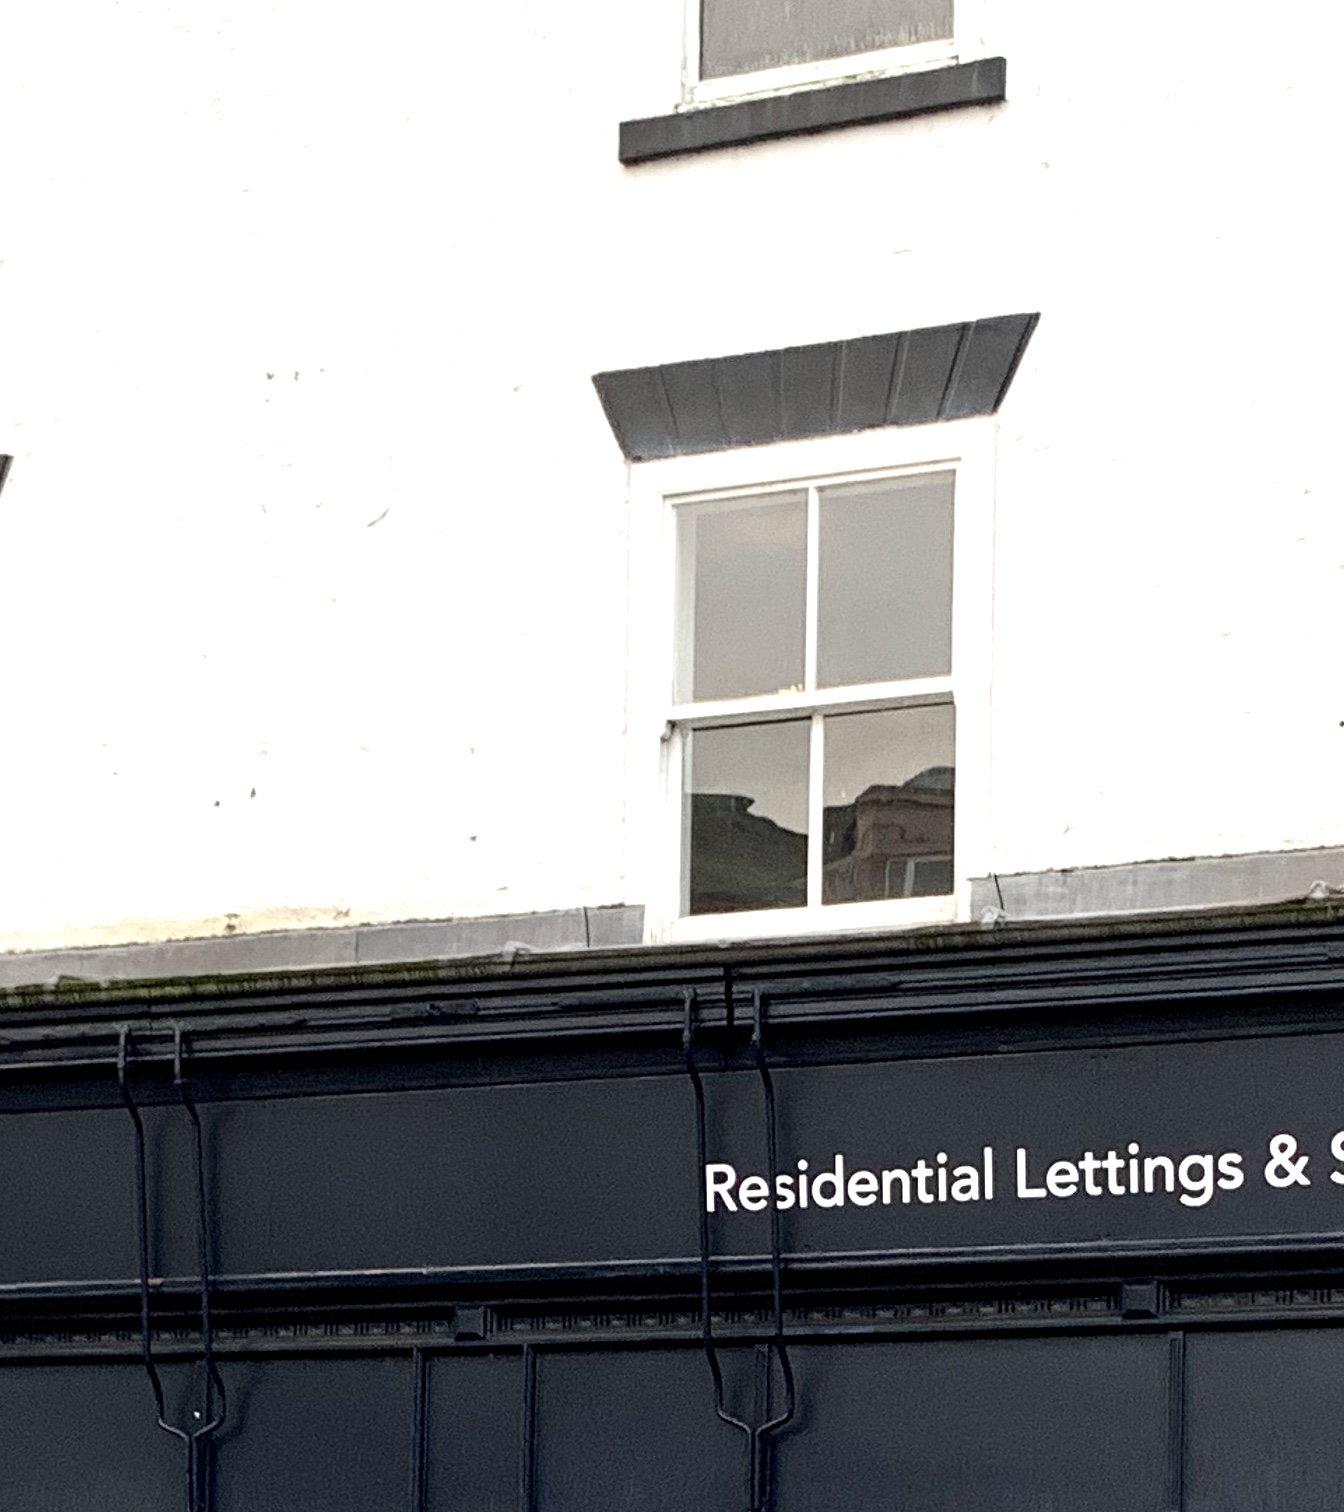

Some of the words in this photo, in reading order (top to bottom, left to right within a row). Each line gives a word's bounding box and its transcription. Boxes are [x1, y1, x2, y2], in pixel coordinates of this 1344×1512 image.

[705, 1147, 995, 1213] Residential
[1015, 1142, 1245, 1207] Lettings
[1265, 1133, 1311, 1188] &
